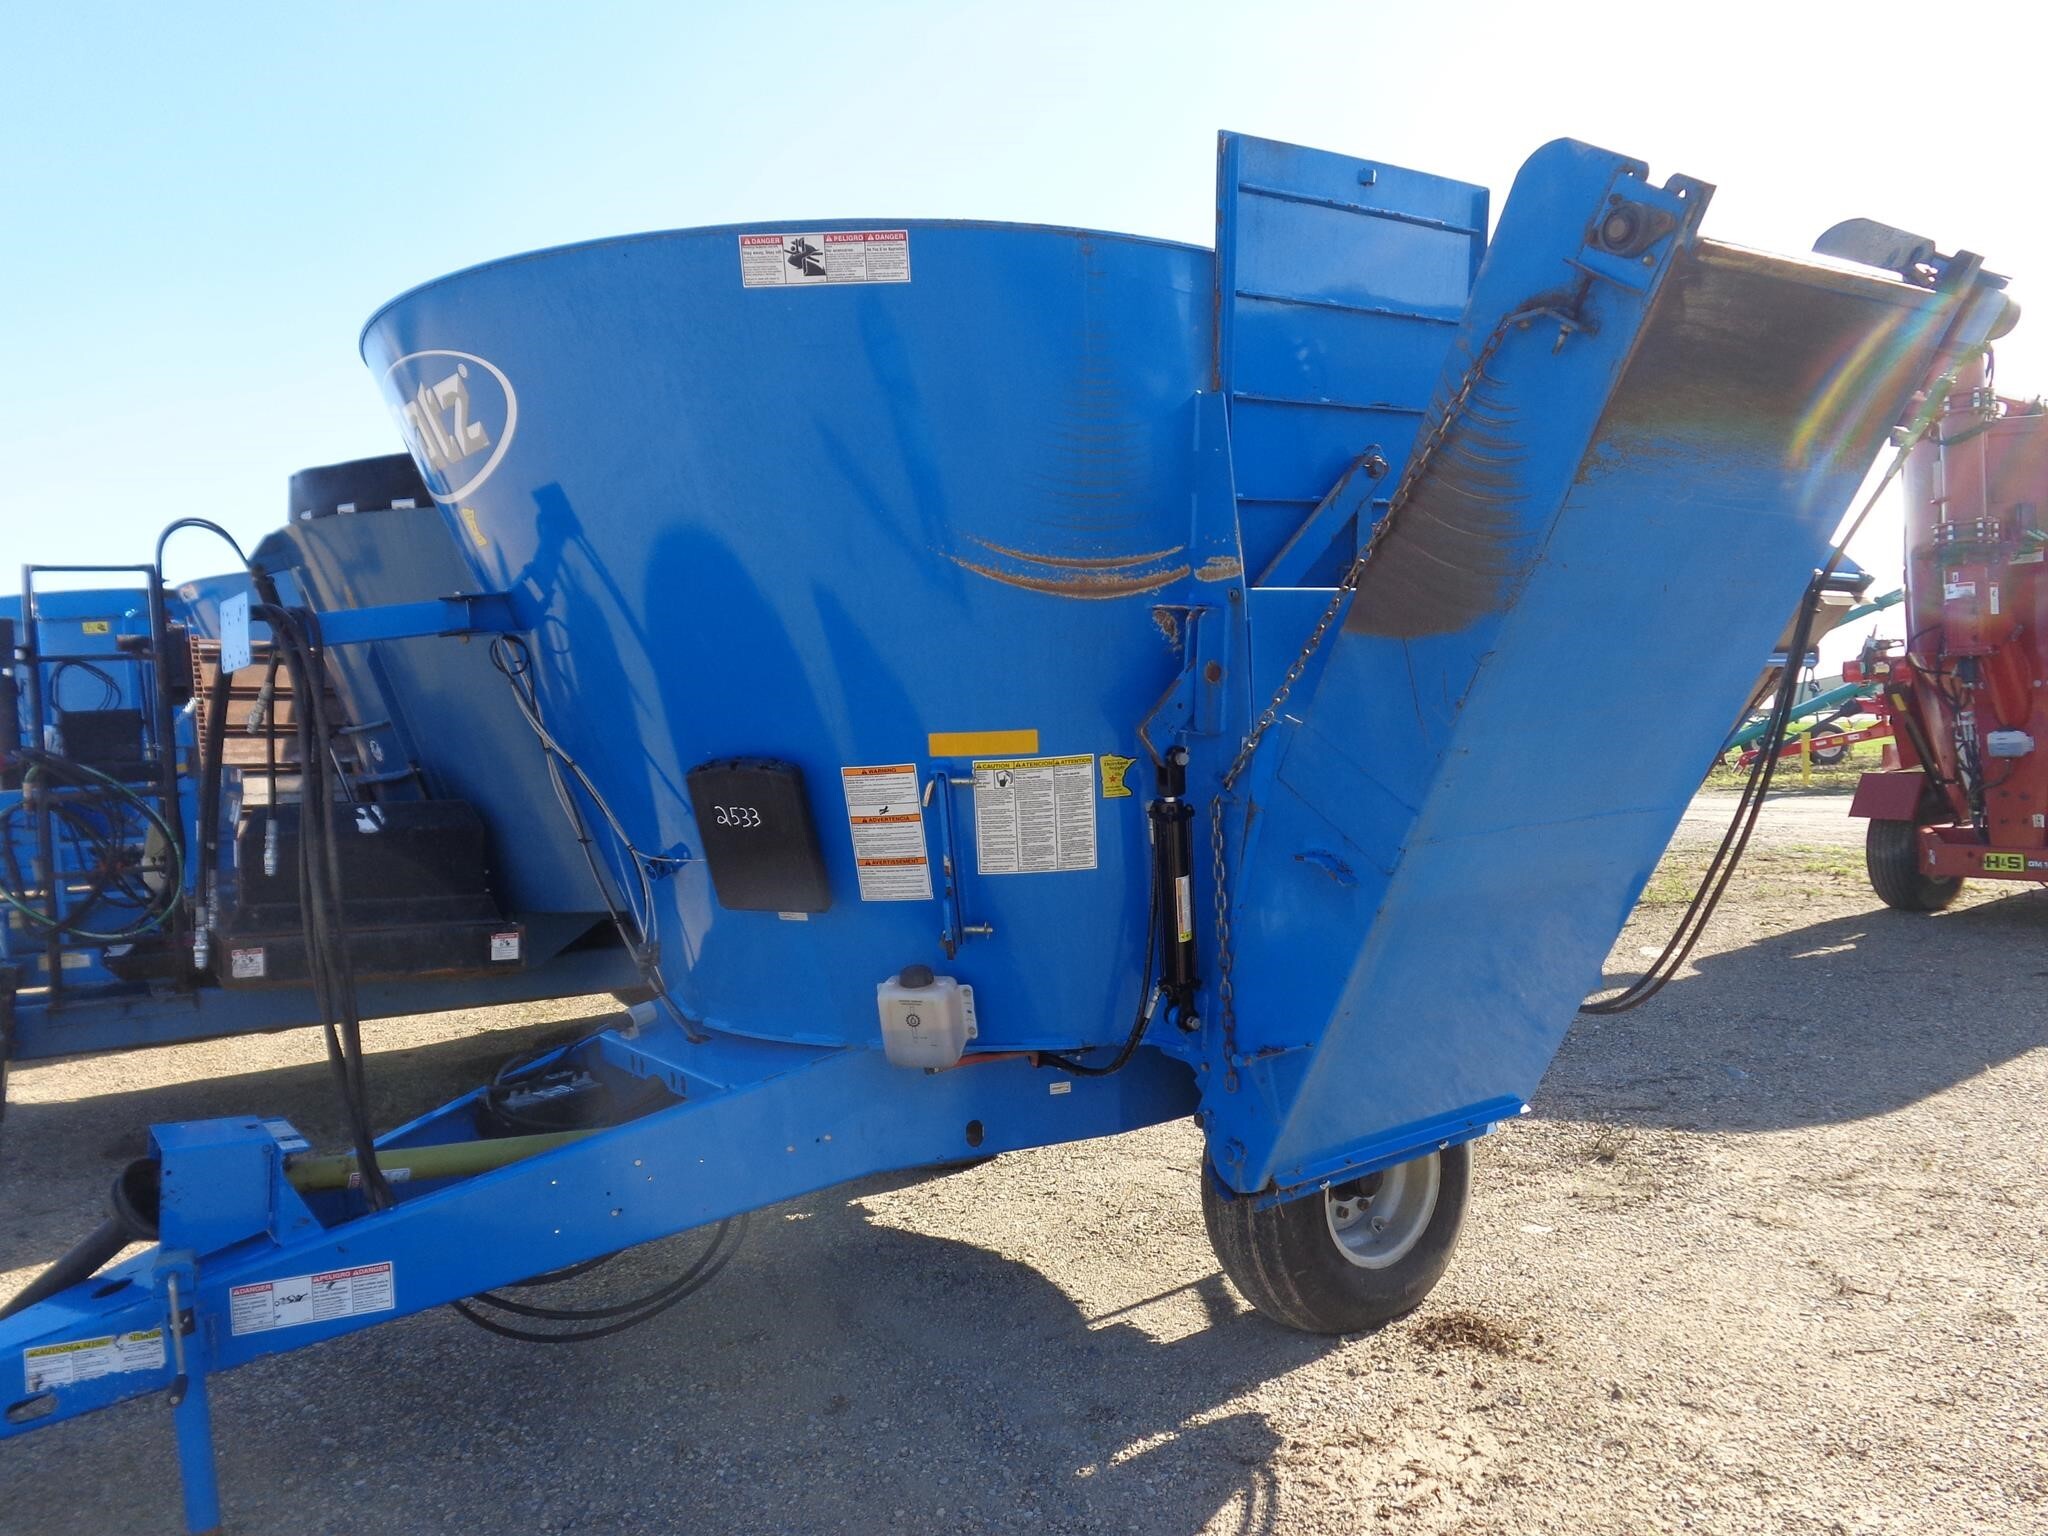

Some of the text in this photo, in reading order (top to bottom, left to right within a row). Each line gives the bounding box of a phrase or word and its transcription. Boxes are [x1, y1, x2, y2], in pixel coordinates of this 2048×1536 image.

[751, 237, 781, 245] DANGER
[833, 234, 864, 242] PELIGRO
[714, 805, 762, 828] 2533
[871, 858, 919, 866] AVERTISSEMENT
[1986, 855, 2021, 870] H&S
[358, 1264, 390, 1275] DANGER
[319, 1271, 351, 1282] PELIGRO
[239, 1284, 272, 1295] DANGER
